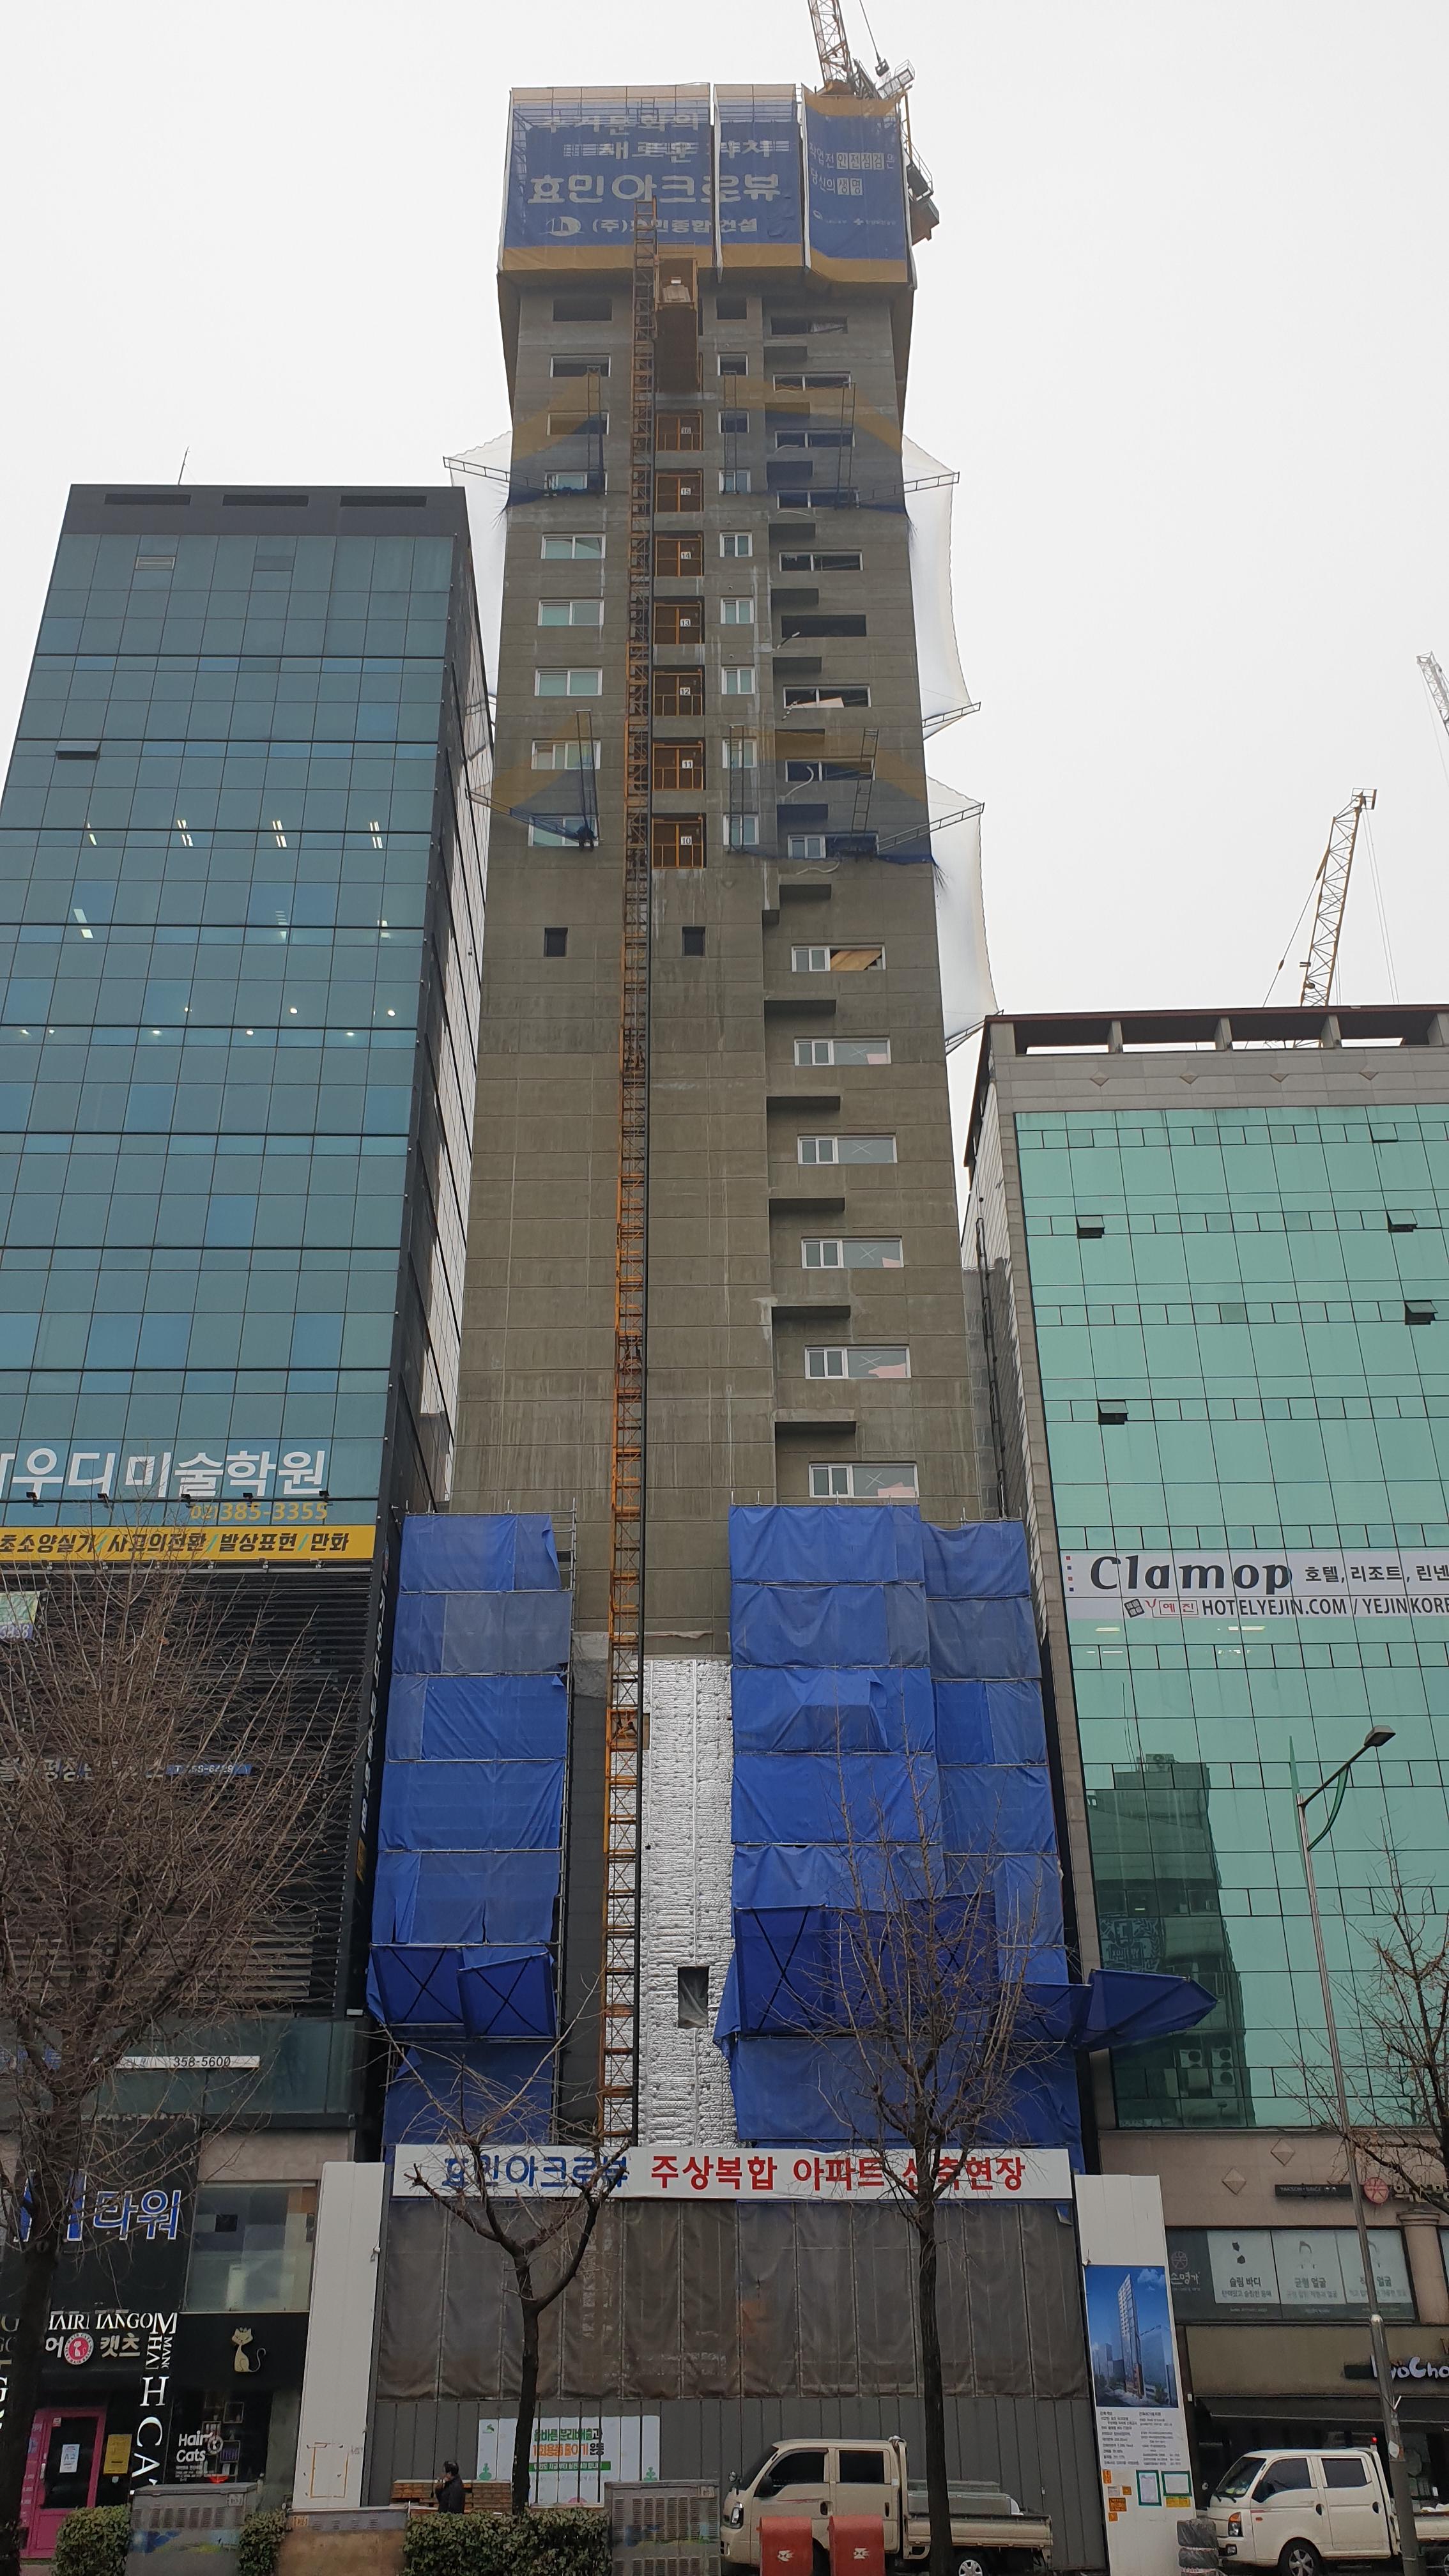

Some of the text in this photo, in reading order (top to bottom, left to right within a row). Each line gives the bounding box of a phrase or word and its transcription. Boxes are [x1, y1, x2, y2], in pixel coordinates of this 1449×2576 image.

[310, 1533, 349, 1552] 만화
[1090, 1554, 1293, 1595] Clamop
[1202, 1598, 1347, 1616] HOTELYEJIN.COM
[651, 2156, 778, 2191] 주상복합
[793, 2156, 885, 2191] 아파트
[93, 2189, 182, 2241] 타워
[1229, 2277, 1262, 2288] 슬림 바디
[178, 2430, 213, 2447] Hair
[176, 2448, 206, 2462] Cats
